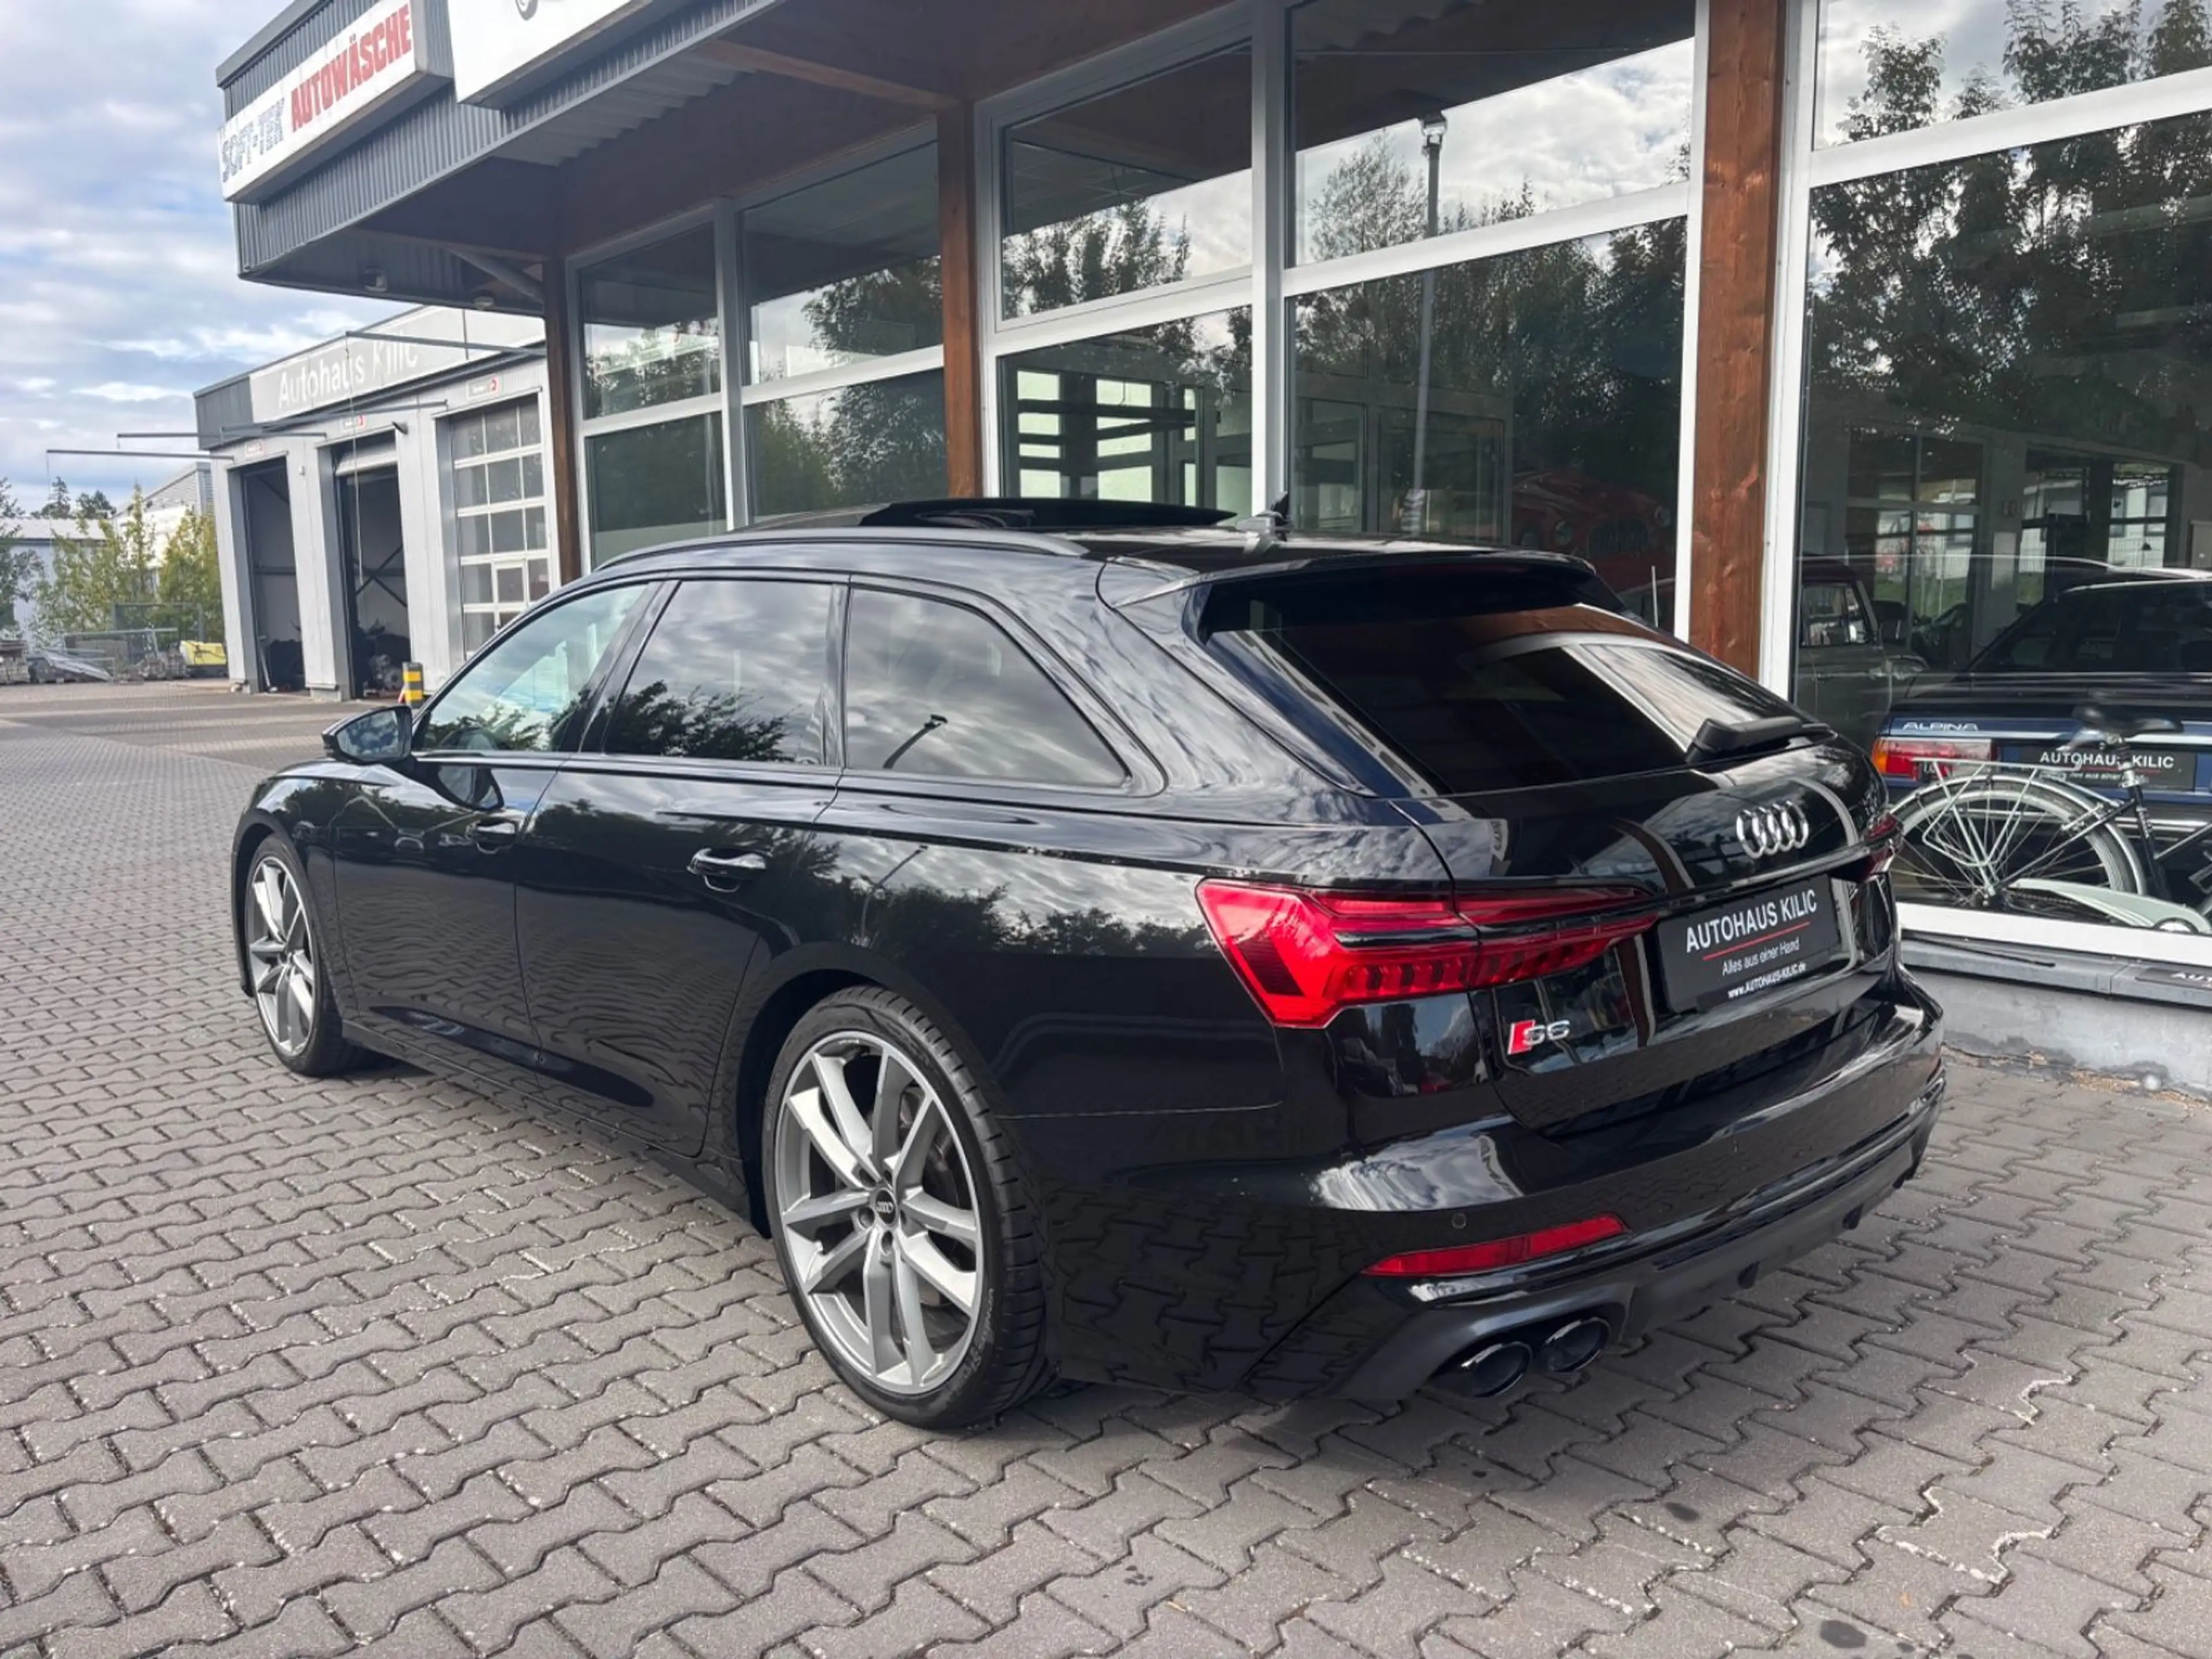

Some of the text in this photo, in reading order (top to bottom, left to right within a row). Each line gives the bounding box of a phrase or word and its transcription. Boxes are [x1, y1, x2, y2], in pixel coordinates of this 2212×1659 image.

[291, 3, 411, 133] AUTOWÄSCHE
[278, 354, 365, 408] Autohaus
[1902, 721, 1979, 732] ALPINA
[2133, 754, 2175, 768] KILIC
[1685, 889, 1818, 953] AUTOHAUS KILIC
[1722, 935, 1800, 976] Alles aus einer Hand
[1522, 1019, 1570, 1046] S6
